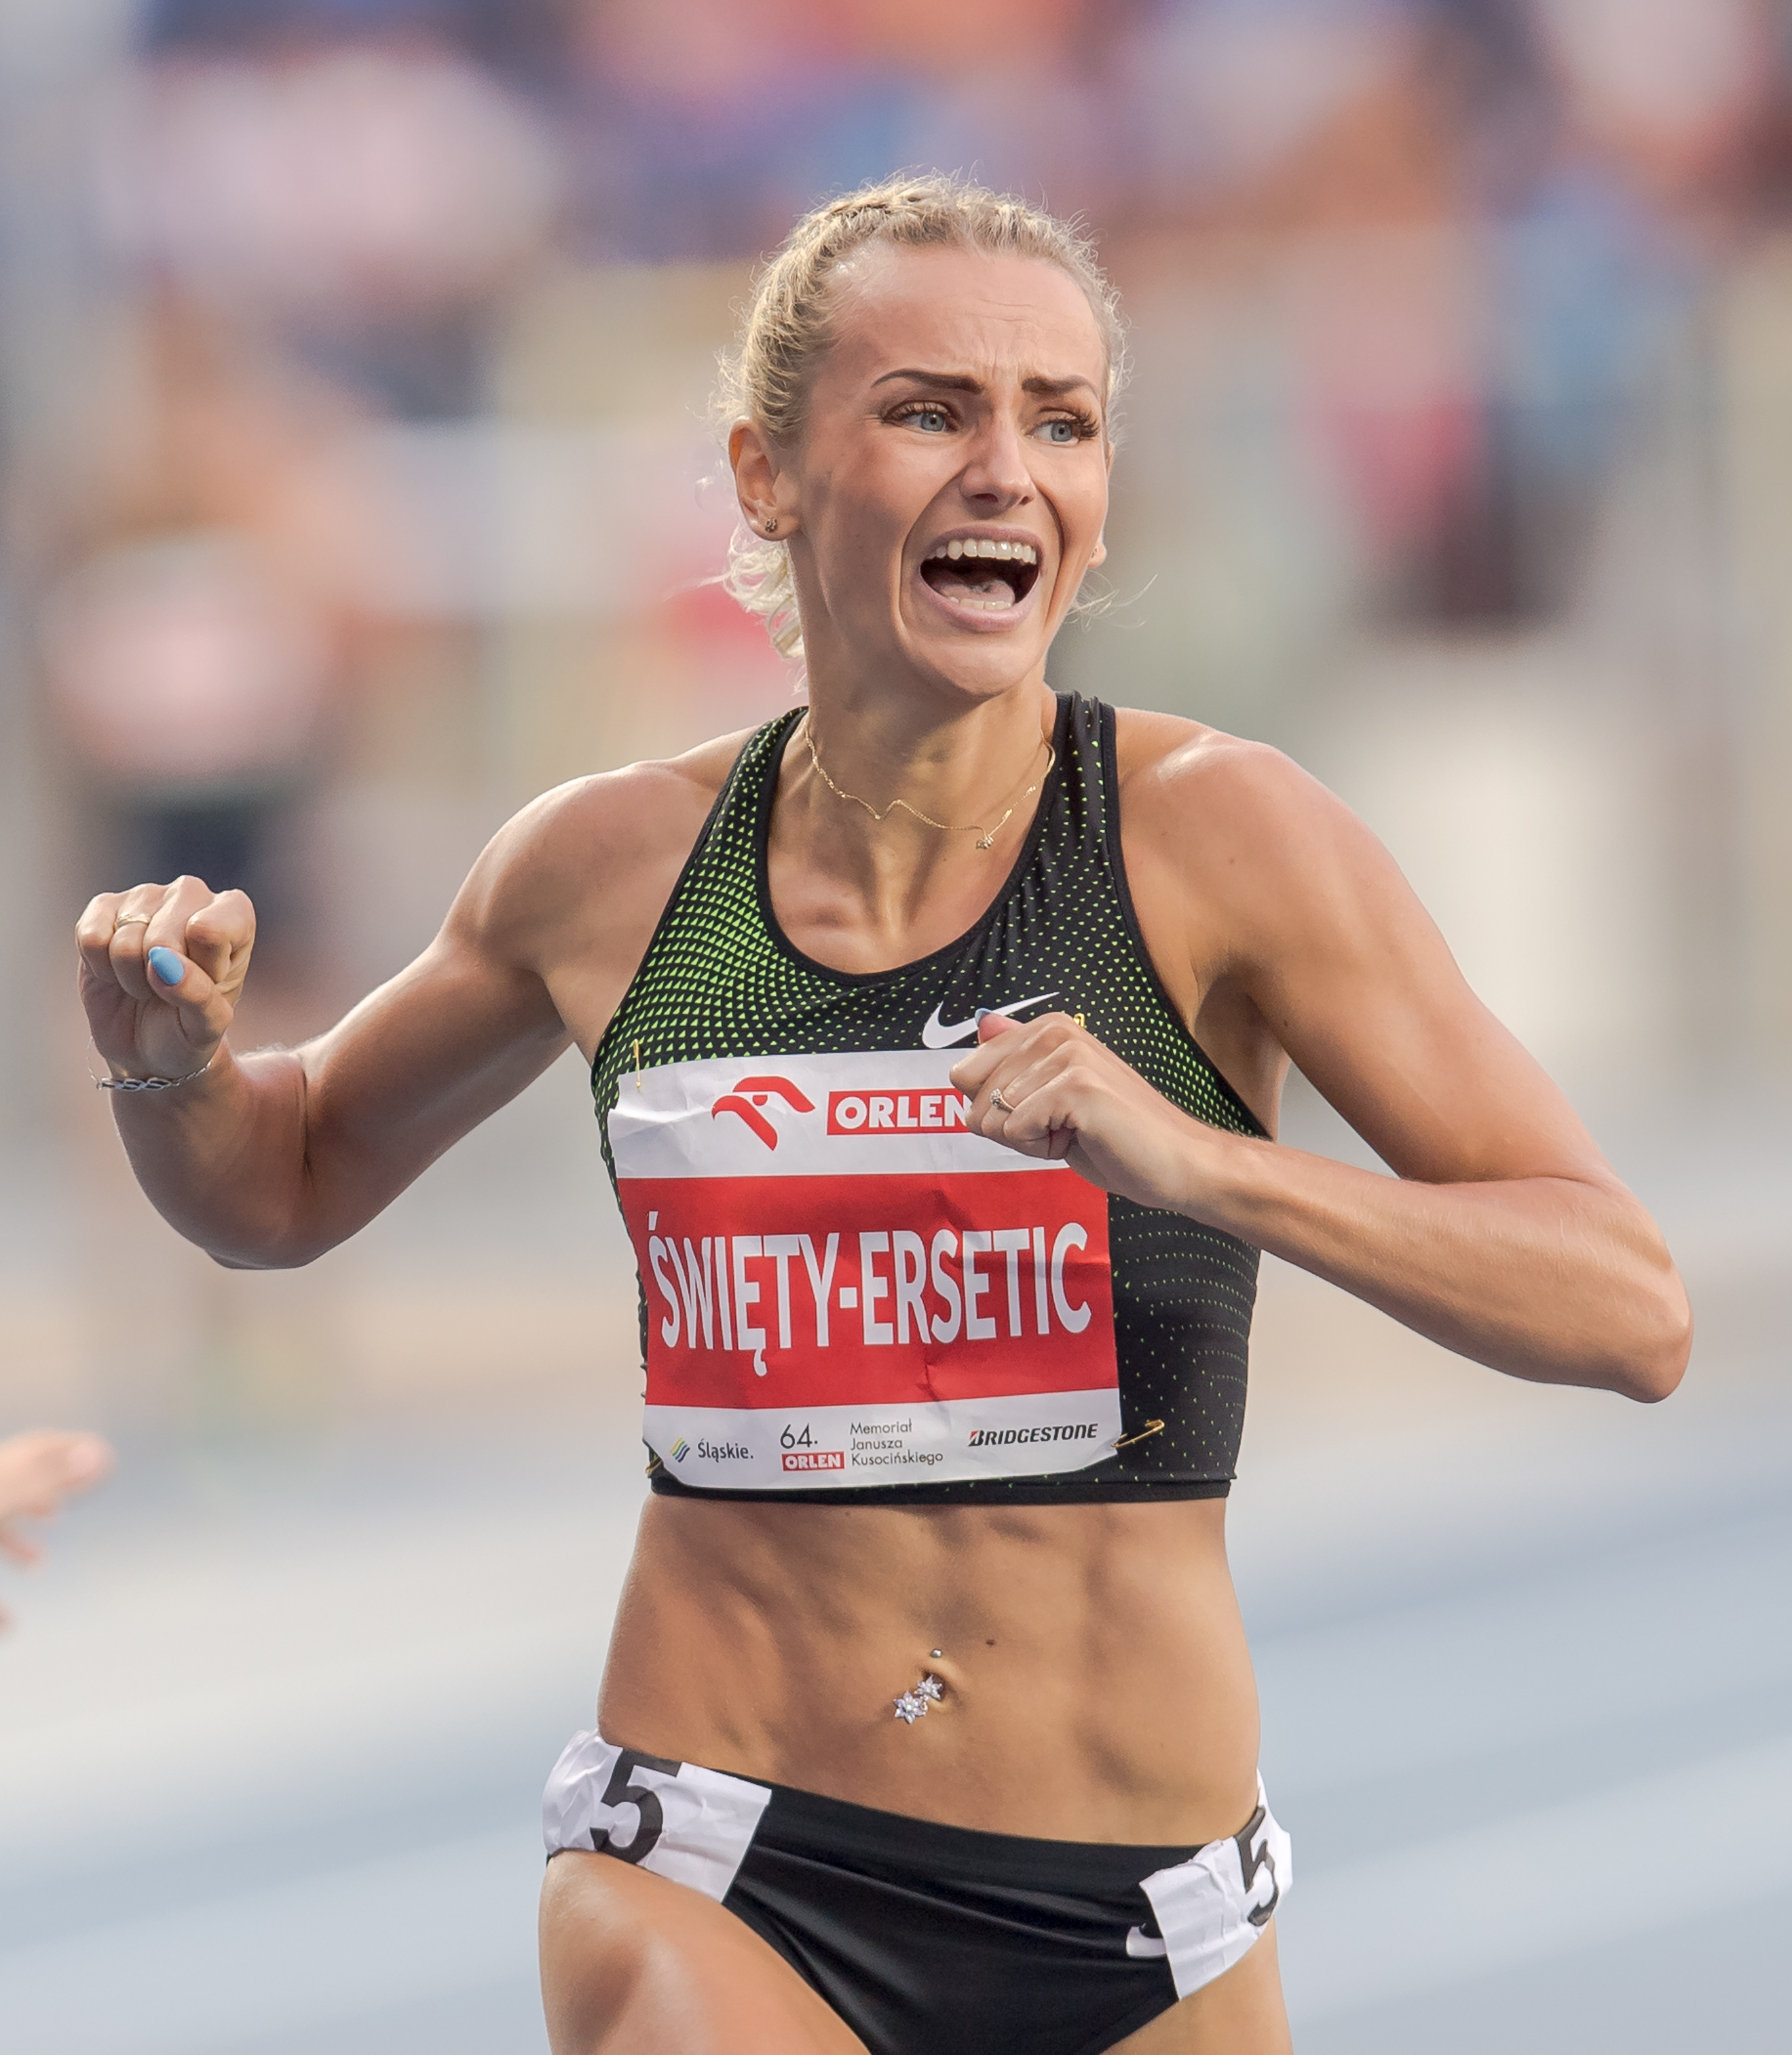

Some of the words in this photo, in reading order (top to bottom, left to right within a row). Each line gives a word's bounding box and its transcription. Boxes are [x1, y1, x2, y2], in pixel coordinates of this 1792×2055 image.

[835, 1093, 971, 1130] ORLEN
[648, 1211, 1091, 1376] ŚWIĘTY-ERSETIC
[779, 1424, 819, 1449] 64.
[849, 1418, 912, 1435] Memoriał
[968, 1423, 1099, 1446] BRIDGESTONE
[697, 1438, 754, 1463] Śląskie.
[851, 1437, 903, 1451] Janusza
[785, 1453, 841, 1469] ORLEN
[851, 1450, 944, 1467] Kusocińskiego
[589, 1748, 682, 1865] 5
[1233, 1805, 1280, 1926] 5
